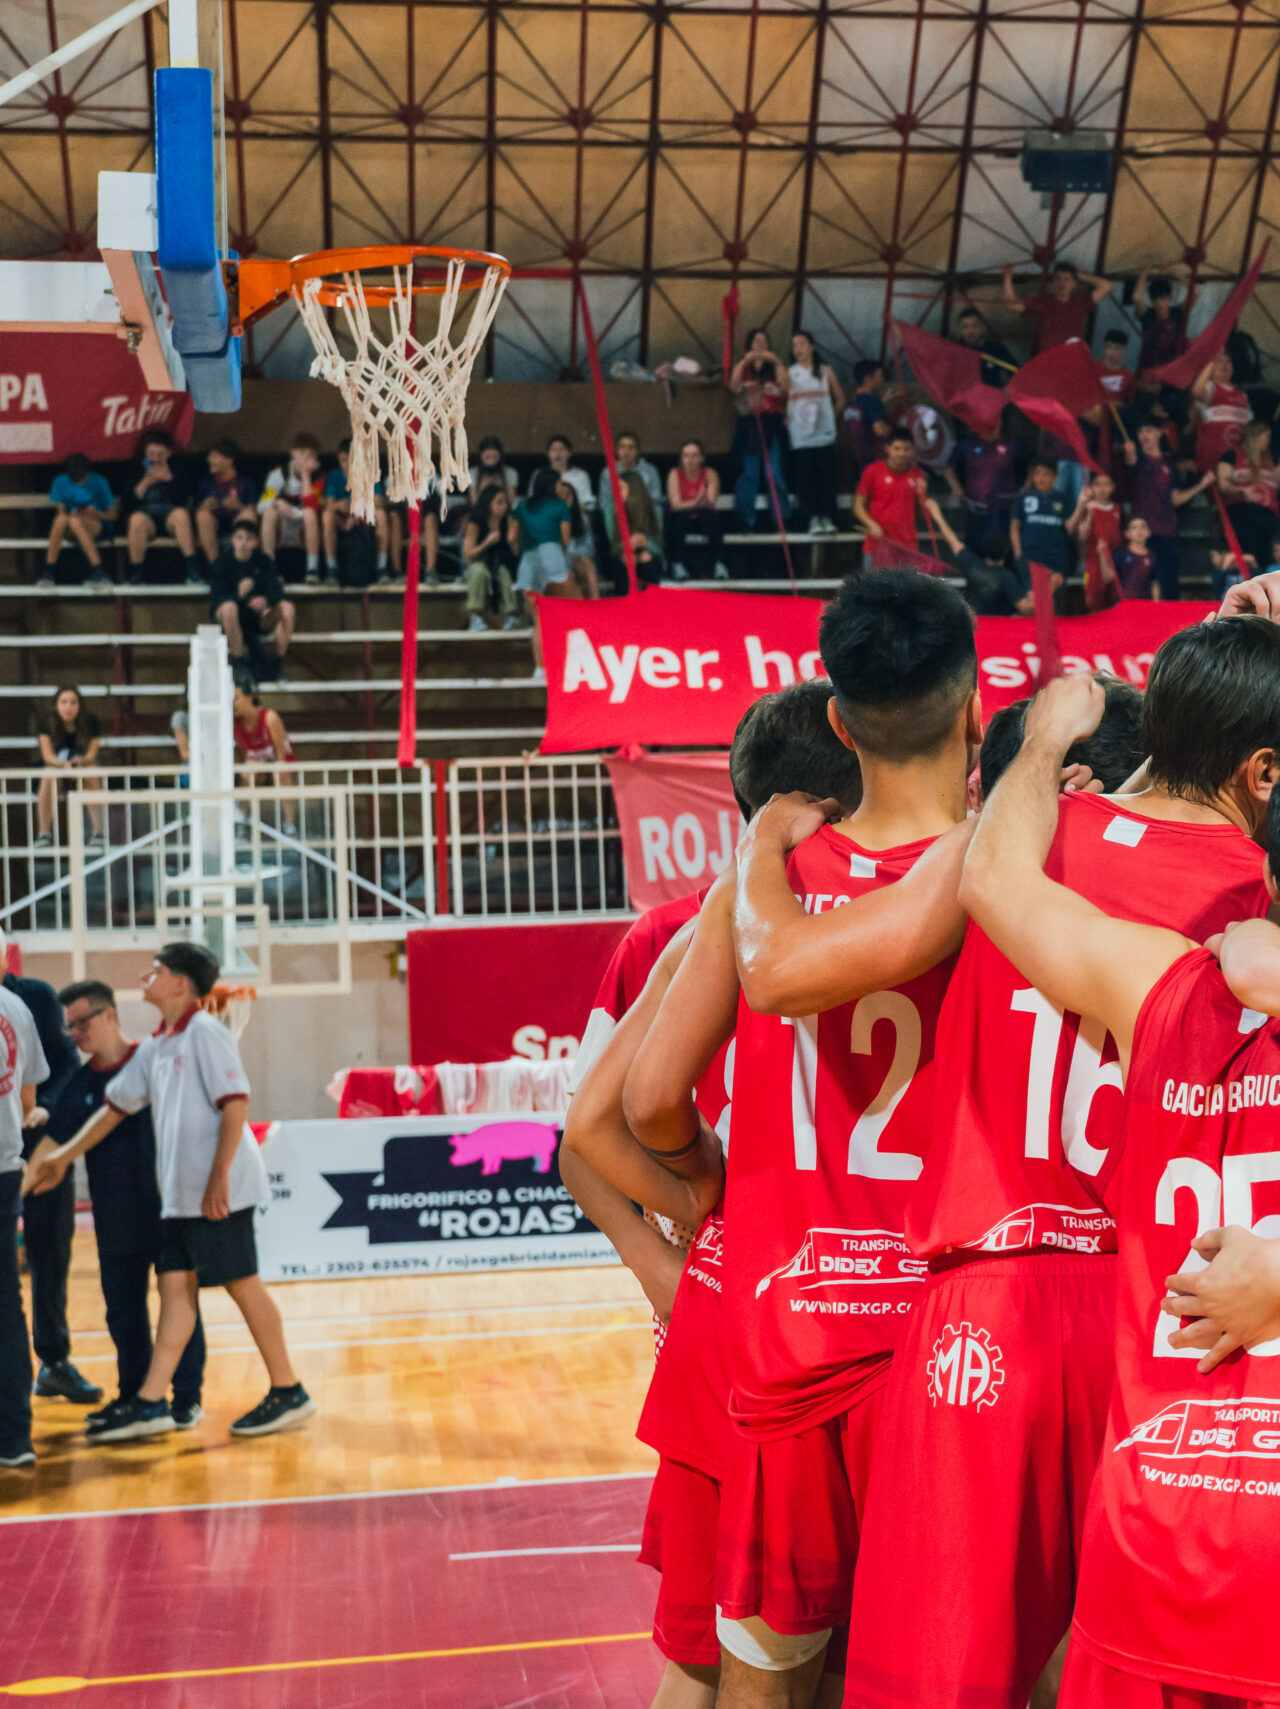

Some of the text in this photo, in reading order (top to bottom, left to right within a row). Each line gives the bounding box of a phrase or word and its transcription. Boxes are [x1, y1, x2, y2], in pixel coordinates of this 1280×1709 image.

[780, 989, 924, 1182] 12
[514, 1185, 574, 1202] CHAC
[818, 1255, 883, 1277] DIDEX
